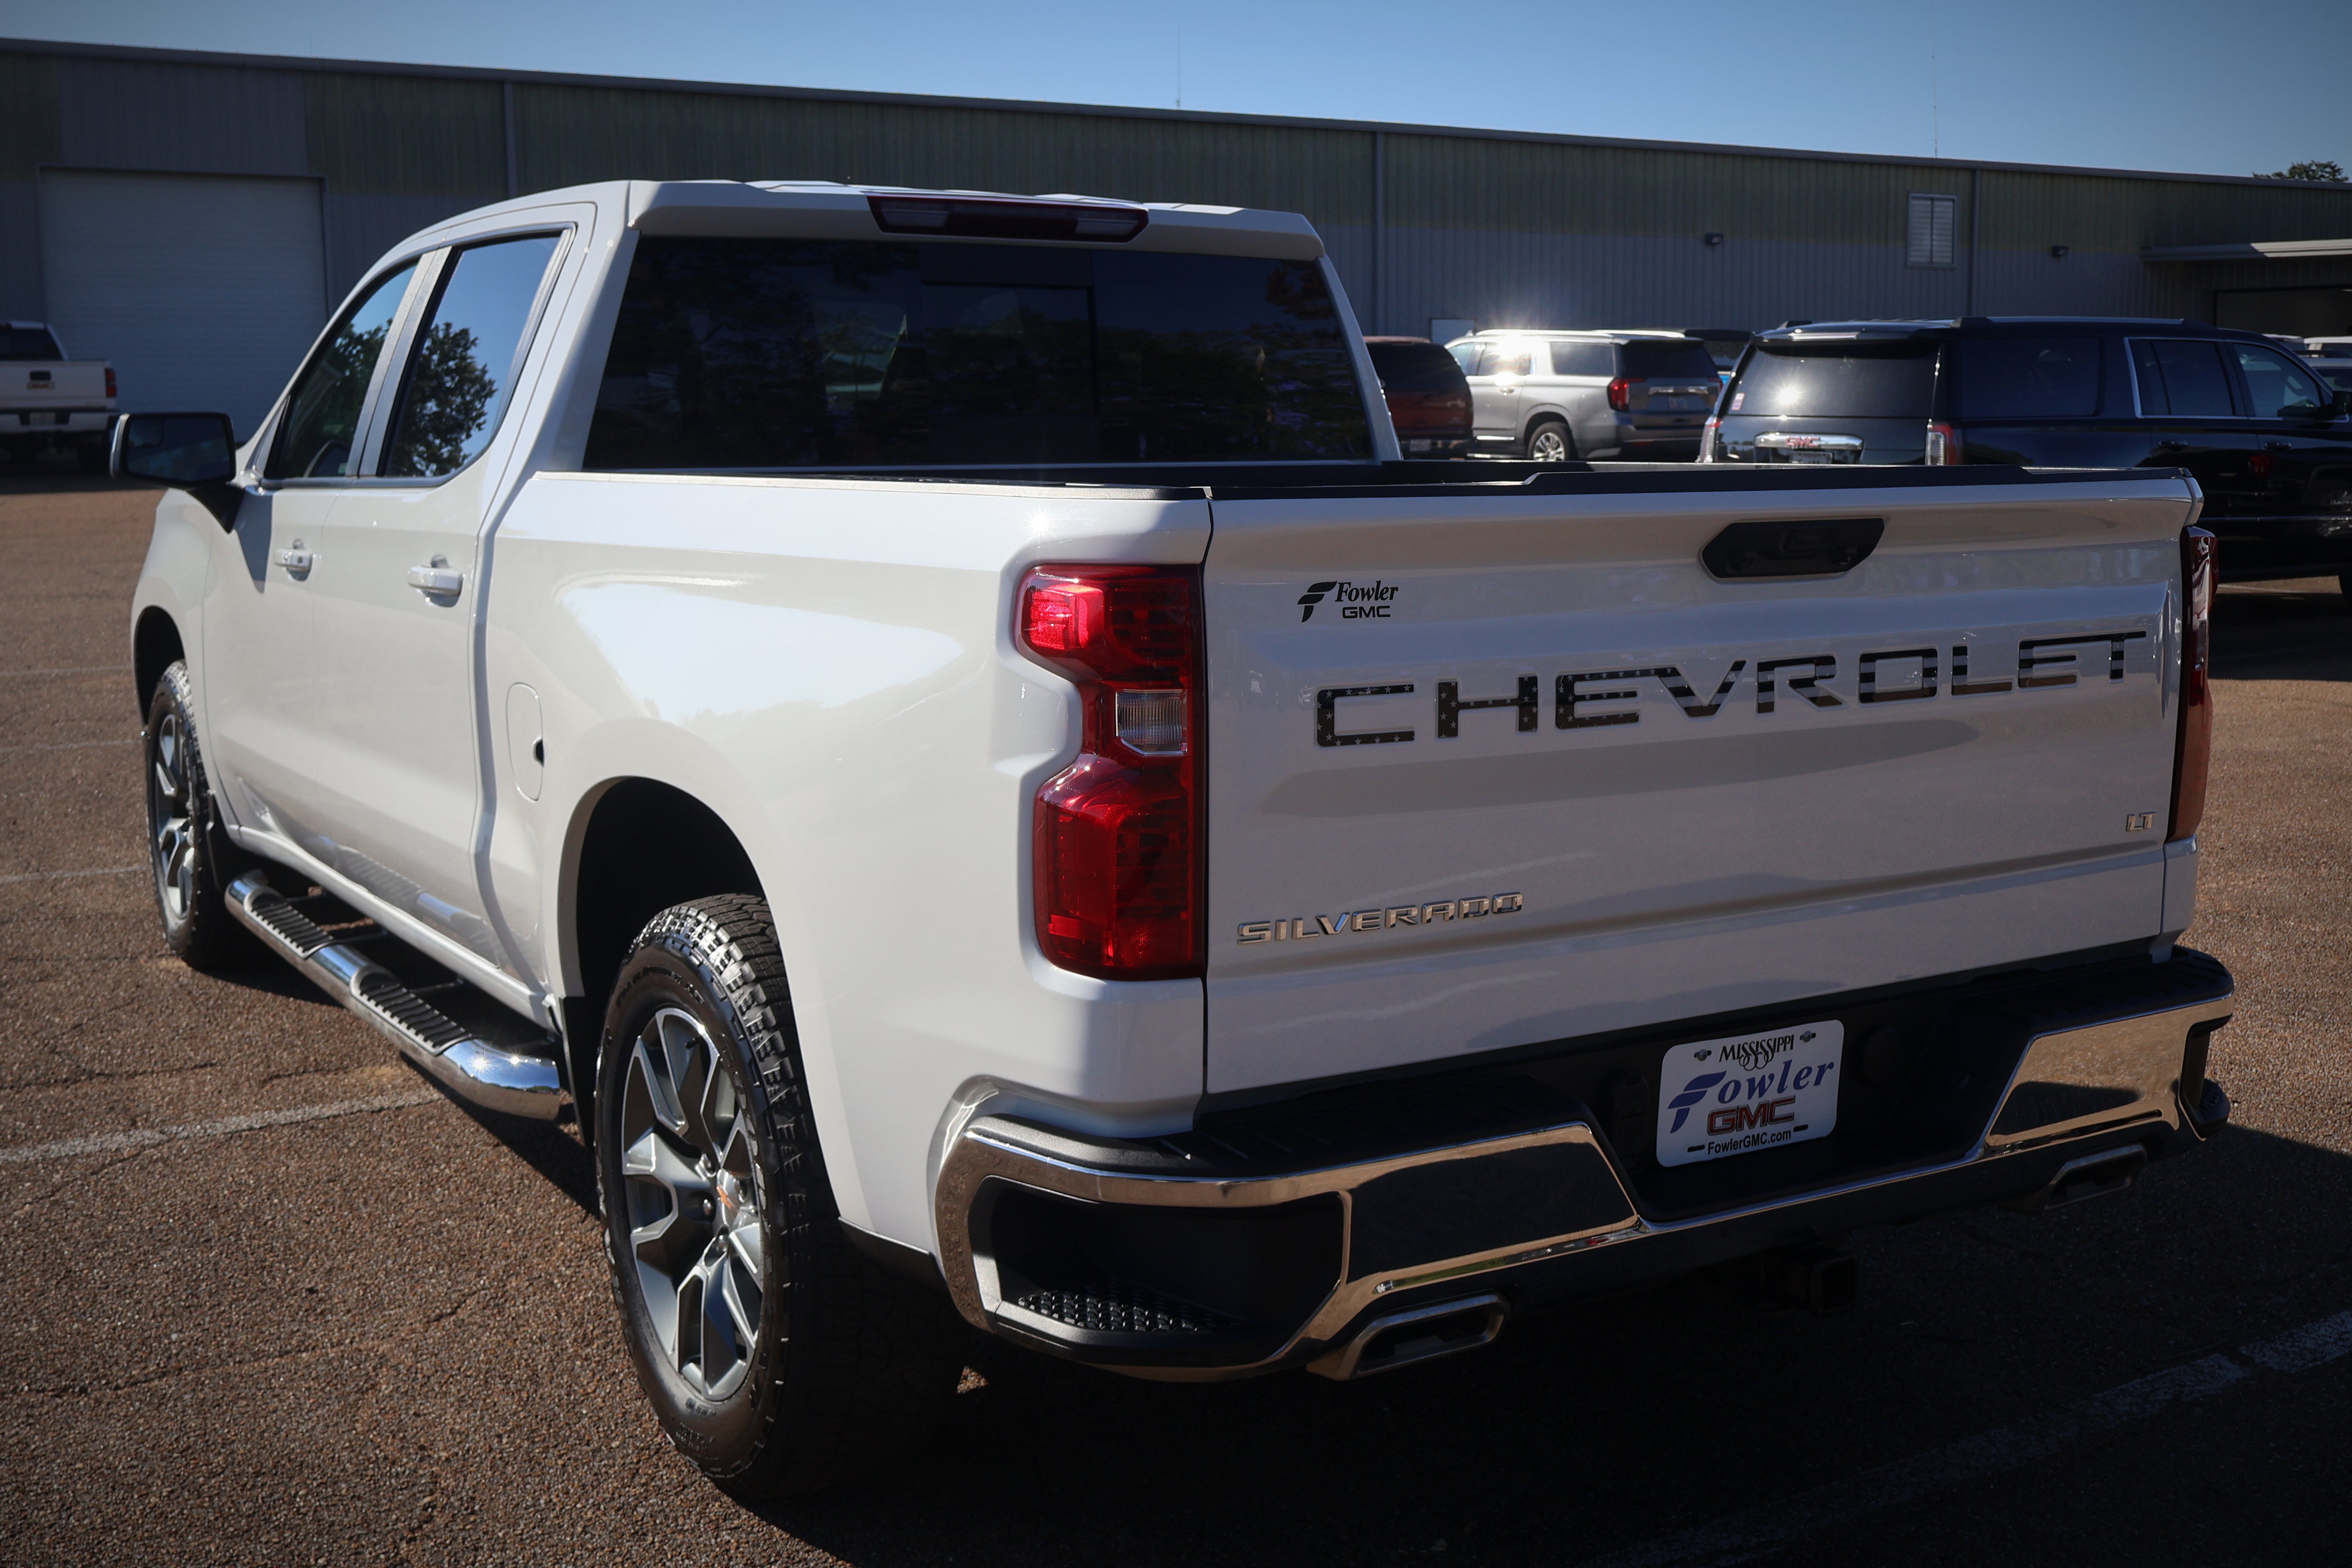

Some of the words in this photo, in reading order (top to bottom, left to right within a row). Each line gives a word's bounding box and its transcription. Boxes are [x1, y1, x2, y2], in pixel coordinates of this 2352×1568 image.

[1785, 436, 1820, 448] GMC
[1335, 580, 1398, 602] Fowler
[1342, 605, 1391, 618] GMC
[1316, 631, 2147, 748] CHEVROLET
[2126, 811, 2157, 832] LT
[1237, 892, 1523, 944] SILVERADO
[1719, 1034, 1795, 1071] MISSISSIPPI
[1667, 1059, 1835, 1134] Fowler
[1707, 1095, 1796, 1136] GMC
[1708, 1130, 1791, 1155] FowlerGMC.com
